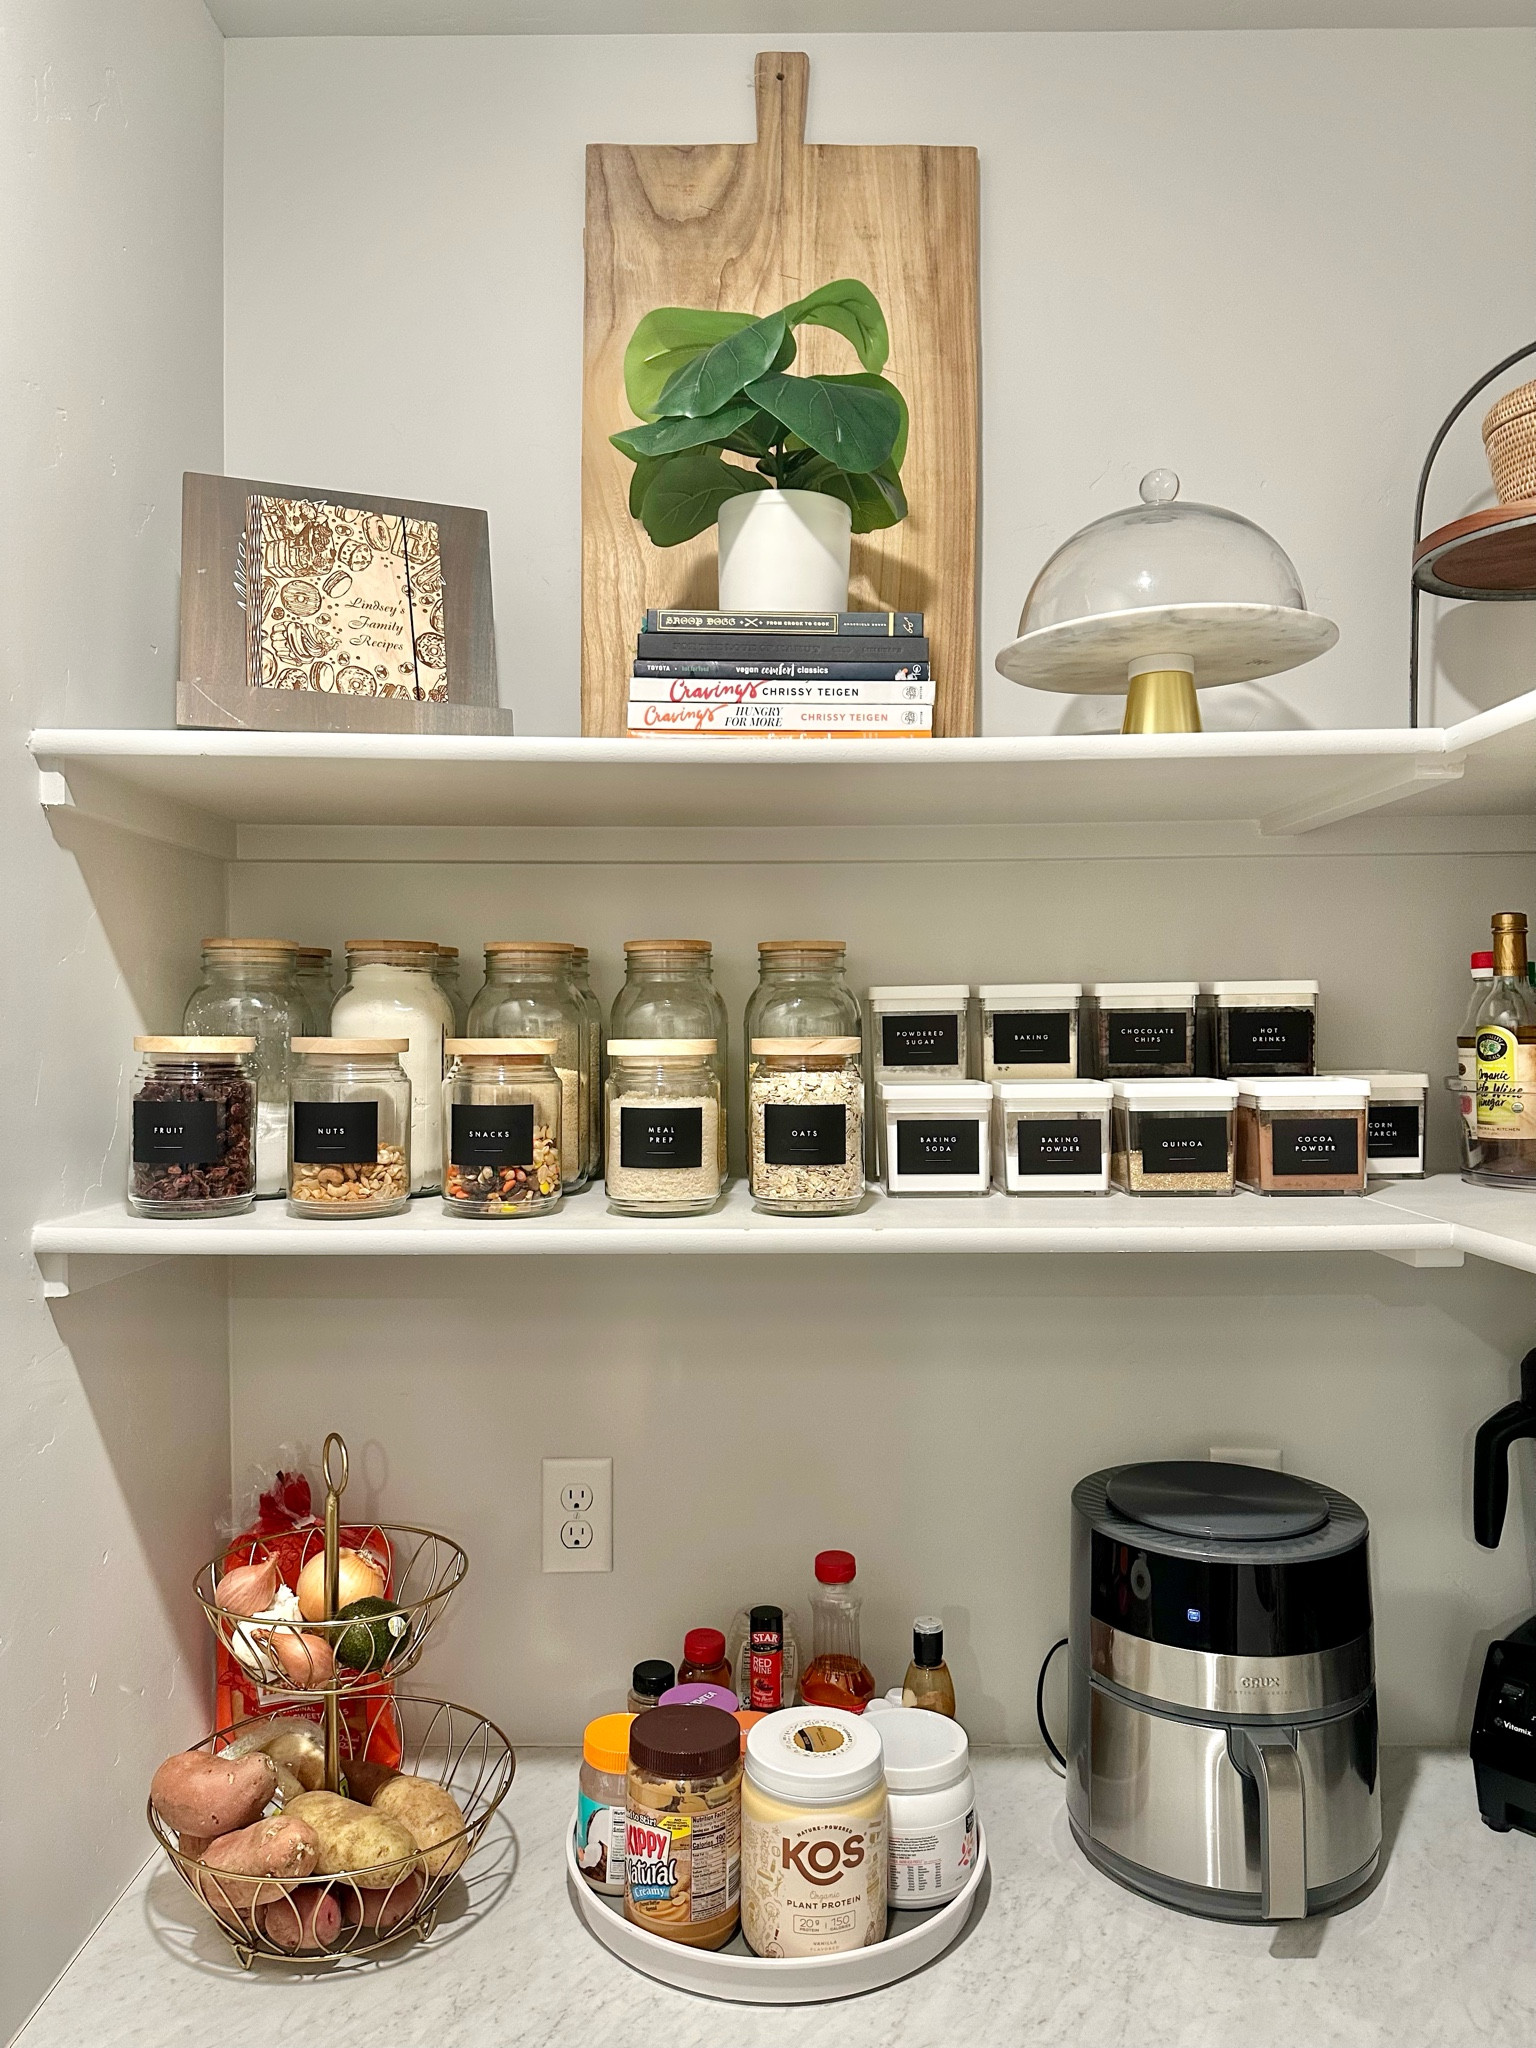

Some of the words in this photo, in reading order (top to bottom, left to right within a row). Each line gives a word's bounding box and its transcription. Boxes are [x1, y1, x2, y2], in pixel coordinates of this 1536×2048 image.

[344, 598, 405, 616] Lindsey's
[348, 616, 404, 635] Family
[349, 634, 404, 652] Recipes
[761, 663, 794, 676] comfort
[670, 678, 774, 703] Cravings
[762, 688, 812, 696] CHRISSY
[818, 688, 859, 696] TEIGEN
[644, 703, 728, 730] Cravings
[736, 707, 783, 716] HUNGRY
[725, 717, 746, 726] FOR
[749, 717, 782, 726] MORE
[753, 1633, 778, 1643] STAR
[753, 1656, 772, 1667] RED
[753, 1664, 772, 1674] WINE
[1241, 1677, 1280, 1688] CRUX
[1504, 1720, 1533, 1736] Vitamix
[797, 1825, 853, 1837] NATURE-POWERED
[626, 1824, 667, 1859] KIPPY
[782, 1834, 865, 1886] KOS
[634, 1888, 666, 1898] Creamy
[810, 1891, 840, 1900] Organic
[787, 1900, 818, 1909] PLANT
[821, 1895, 861, 1909] PROTEIN
[831, 1916, 850, 1926] 150
